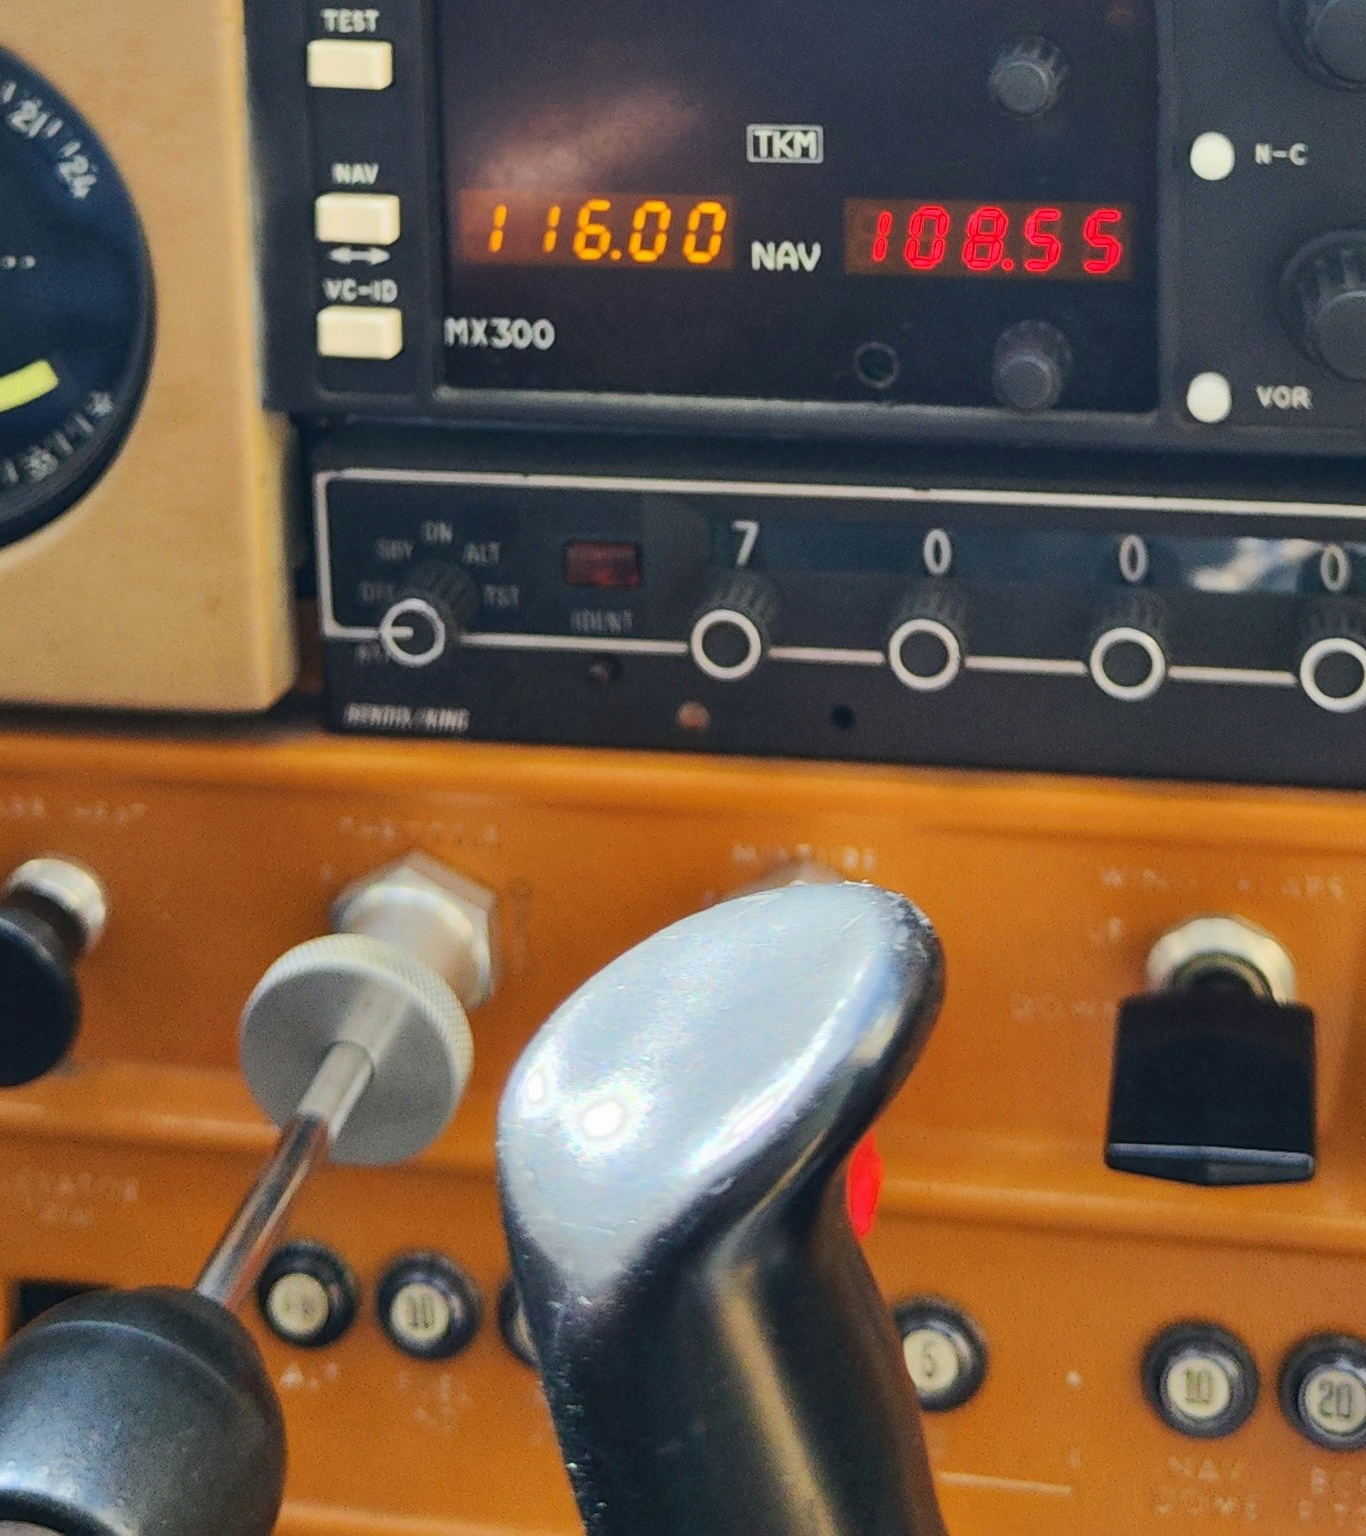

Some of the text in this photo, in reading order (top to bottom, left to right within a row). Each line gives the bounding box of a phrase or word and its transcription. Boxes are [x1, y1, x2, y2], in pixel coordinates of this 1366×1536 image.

[321, 8, 380, 35] TEST
[9, 98, 45, 140] 21
[749, 128, 821, 160] TKM
[1253, 142, 1308, 167] N-C
[56, 153, 99, 200] 24
[331, 161, 380, 187] NAV
[489, 198, 727, 266] 116.00
[871, 206, 1123, 275] 108.55
[750, 240, 823, 272] NAV
[445, 317, 556, 351] MX300
[1255, 385, 1313, 410] VOR
[419, 518, 455, 545] ON
[462, 540, 502, 567] ALT
[732, 521, 1349, 592] 7 0 0 0
[921, 1340, 938, 1380] 5
[1315, 1378, 1354, 1420] 20
